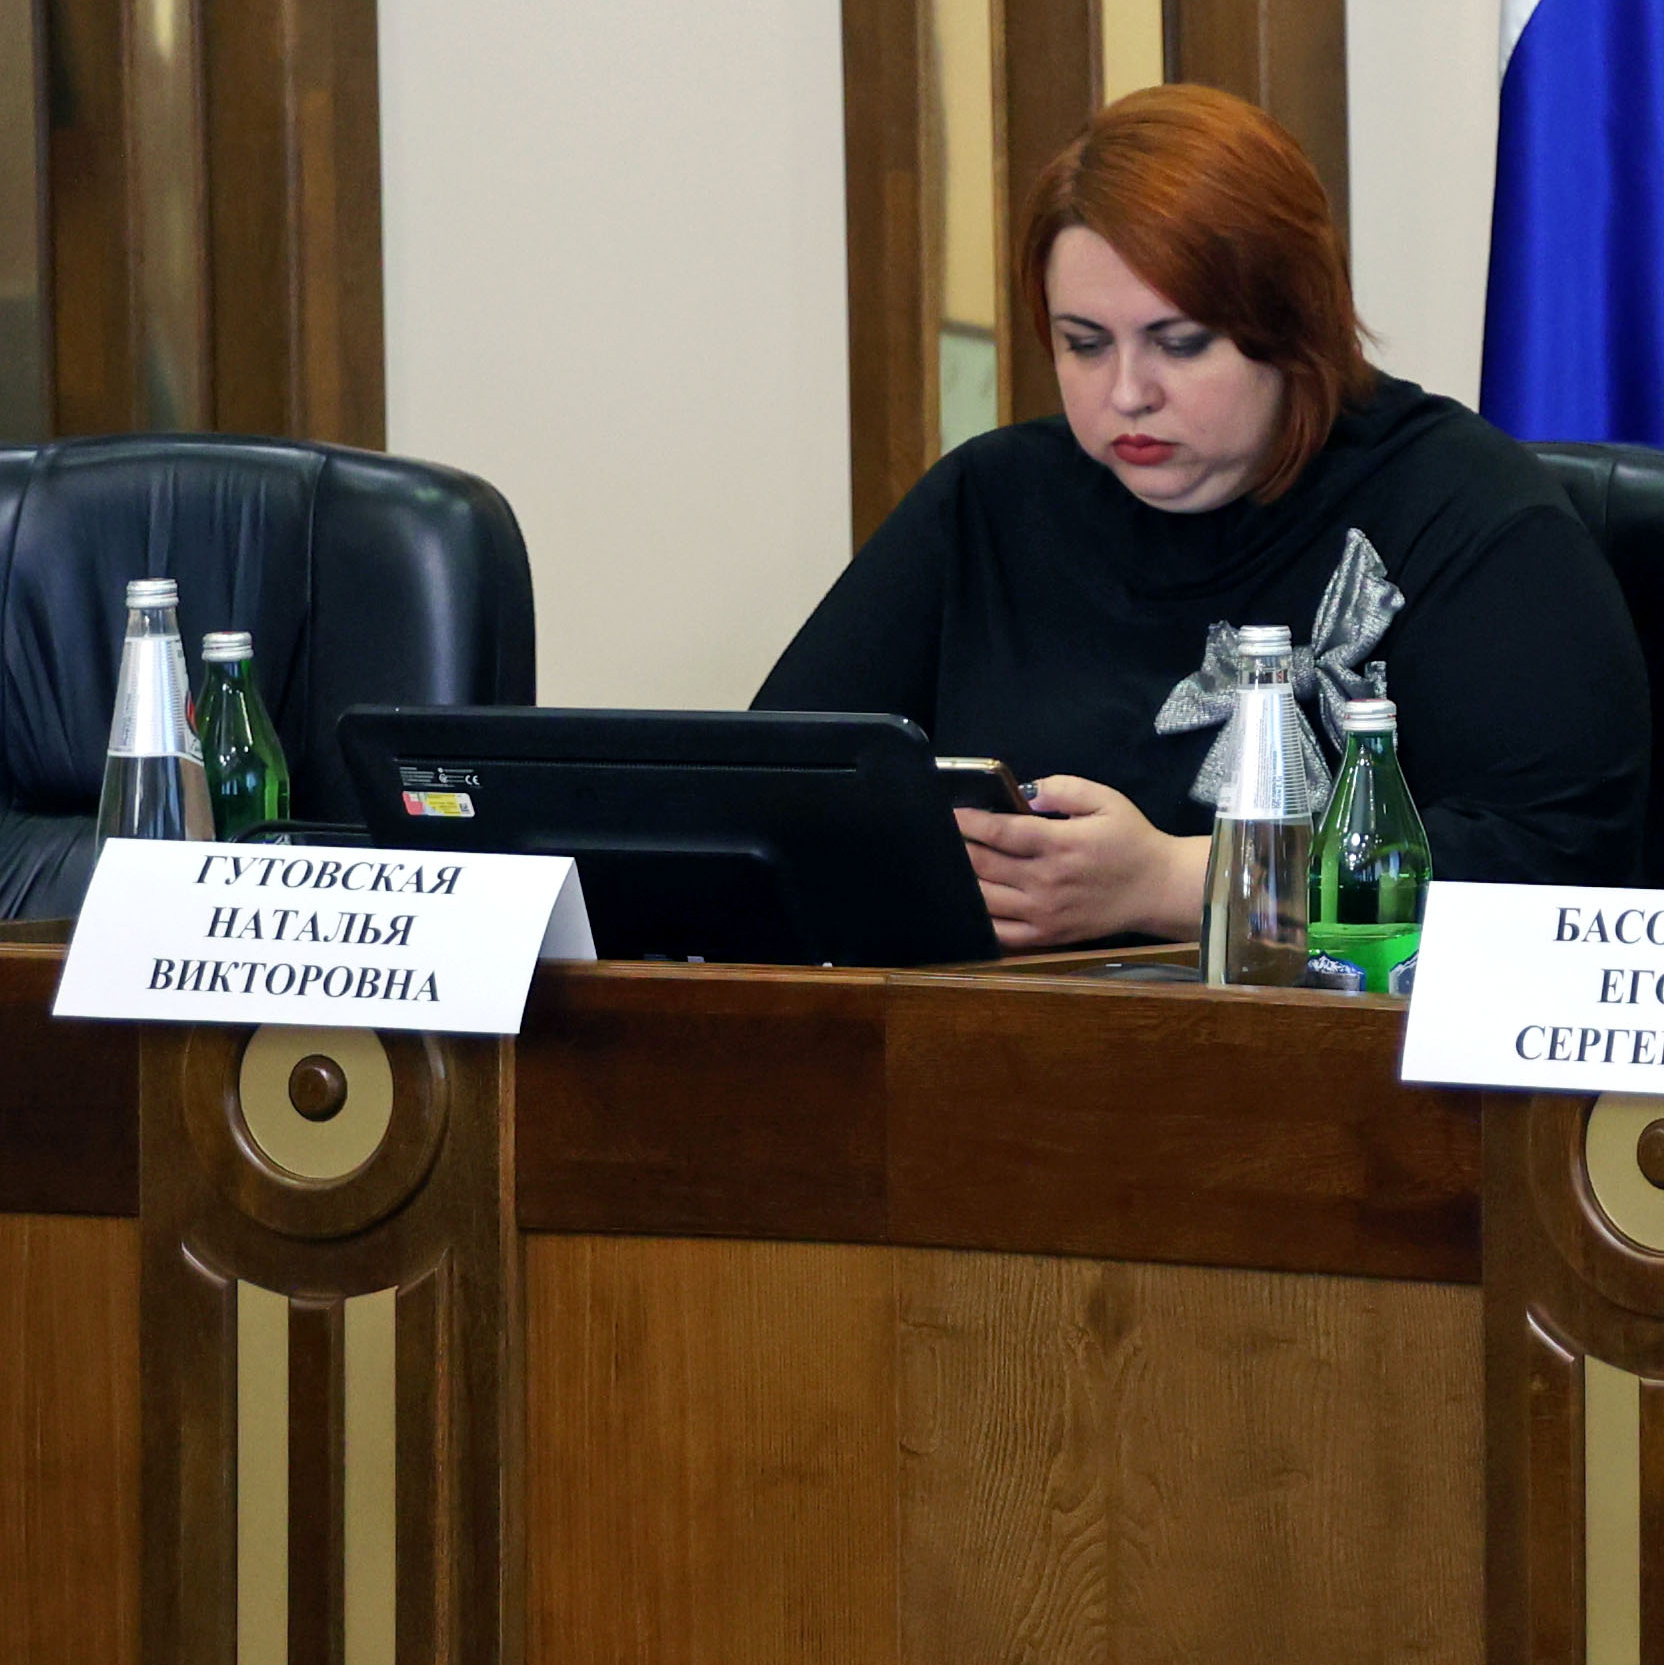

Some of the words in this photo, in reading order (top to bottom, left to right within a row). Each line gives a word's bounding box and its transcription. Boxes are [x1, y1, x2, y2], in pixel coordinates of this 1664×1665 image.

[194, 855, 465, 895] ГУТОВСКАЯ
[204, 906, 417, 946] НАТАЛЬЯ
[147, 958, 441, 1002] ВИКТОРОВНА
